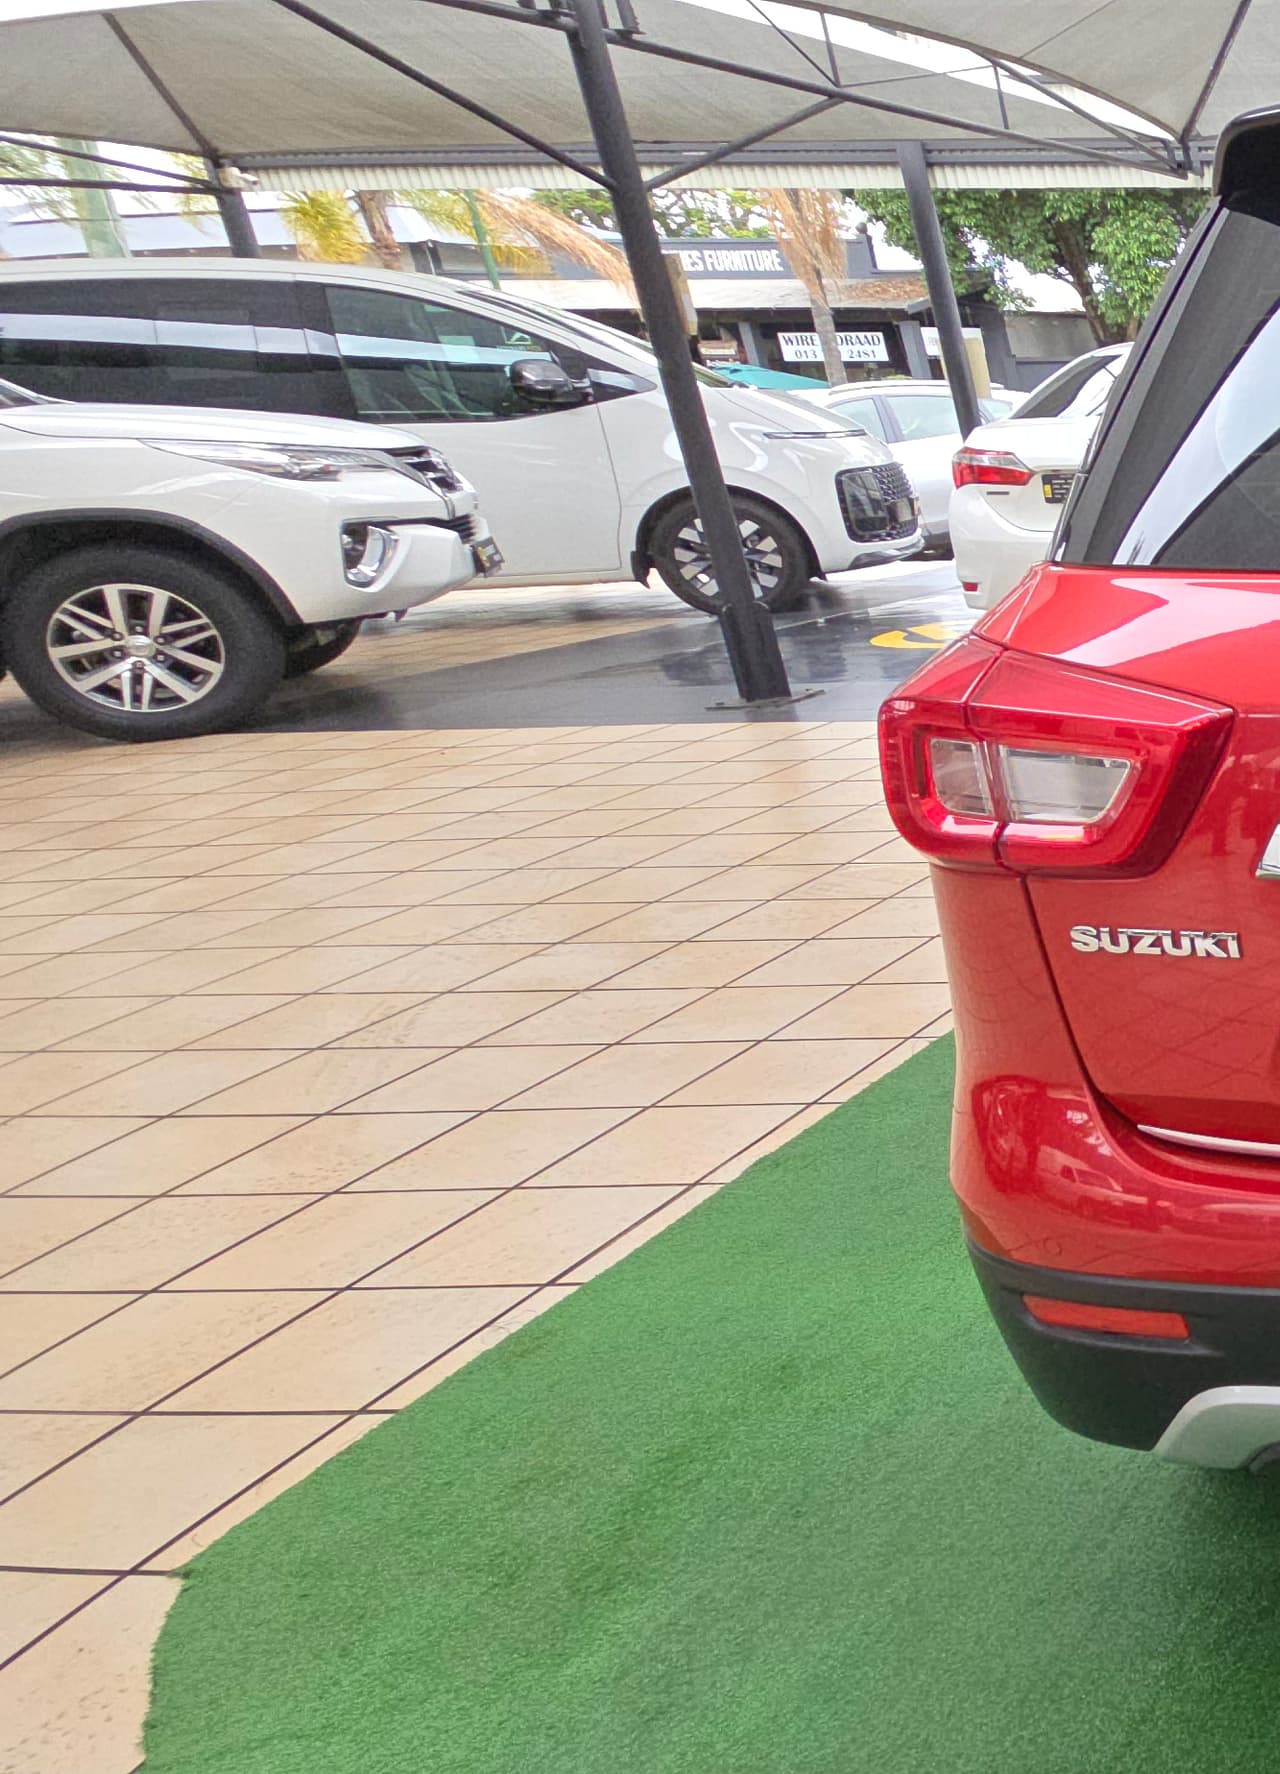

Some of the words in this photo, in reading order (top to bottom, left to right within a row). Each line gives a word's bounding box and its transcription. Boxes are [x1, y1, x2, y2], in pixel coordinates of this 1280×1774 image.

[702, 249, 784, 272] FURNITURE
[782, 334, 818, 347] WIRE
[794, 349, 818, 360] 013
[1069, 924, 1241, 959] SUZUKI
